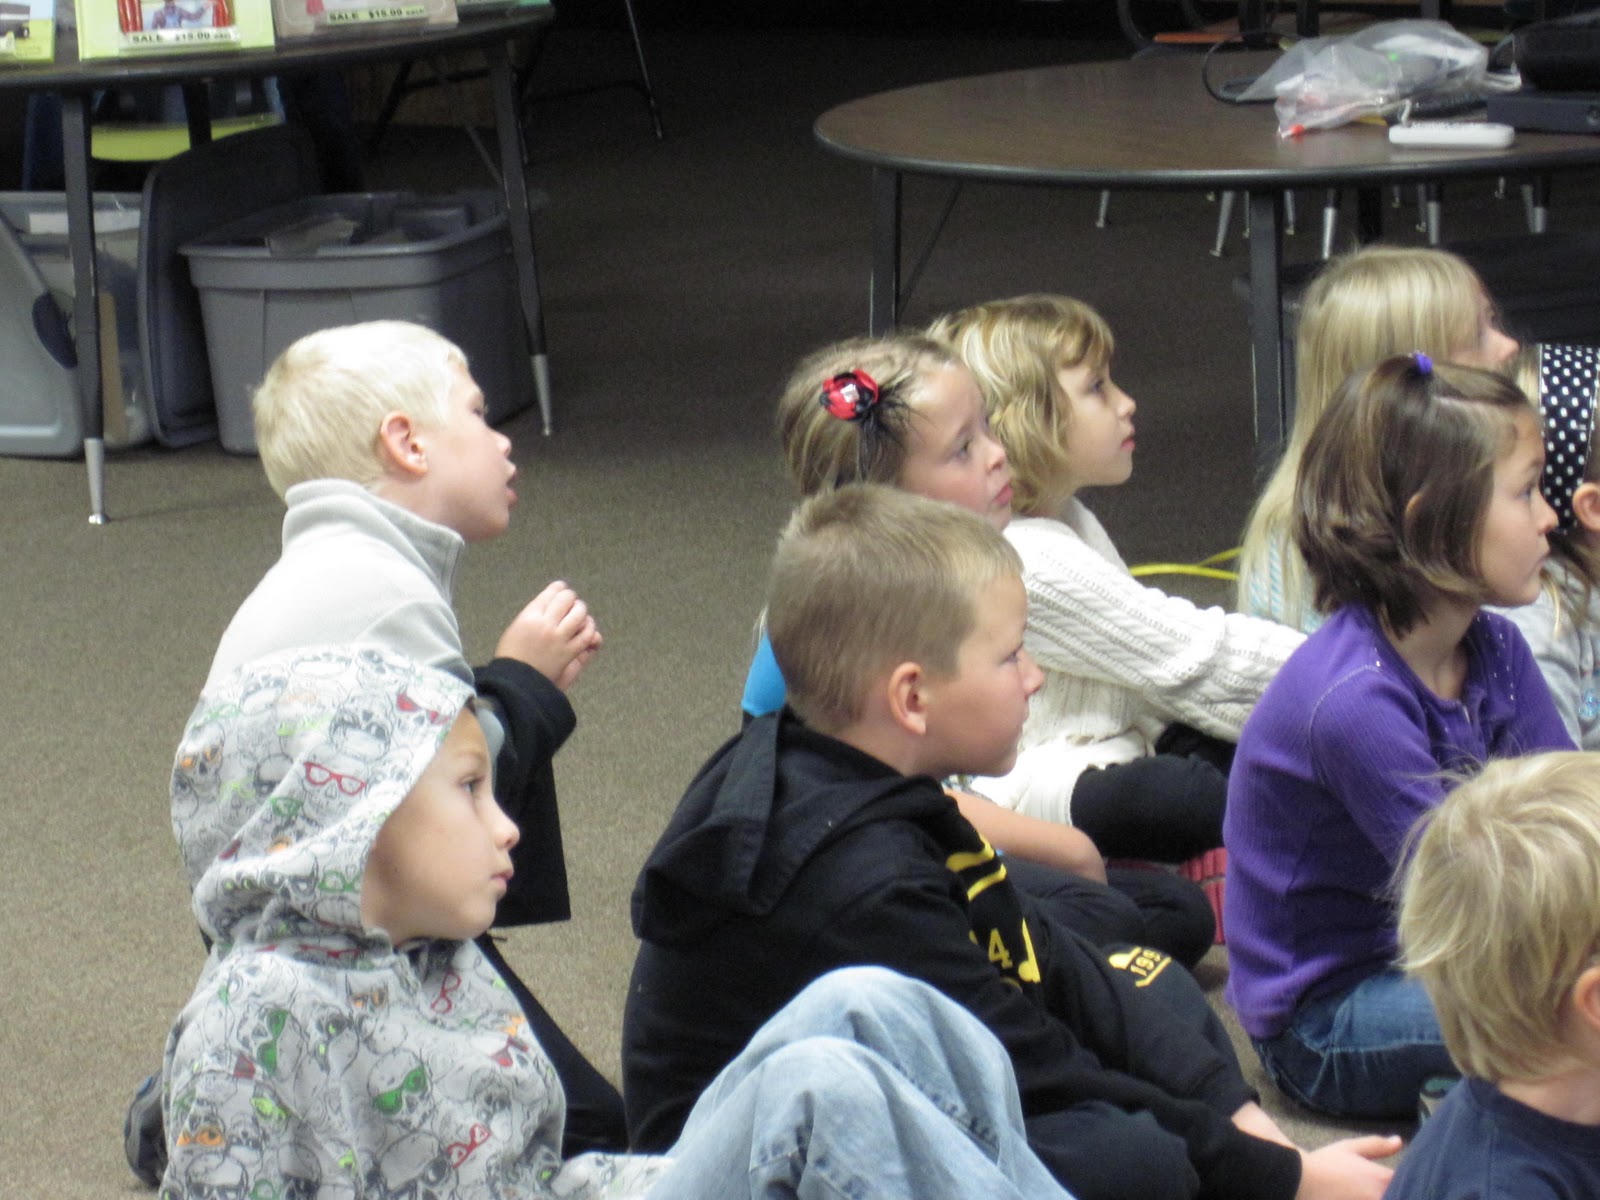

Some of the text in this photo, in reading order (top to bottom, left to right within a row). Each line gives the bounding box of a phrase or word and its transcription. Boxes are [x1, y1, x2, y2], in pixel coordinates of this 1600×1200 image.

[329, 11, 359, 21] SALE
[368, 8, 403, 19] $15.00
[132, 34, 162, 43] SALE
